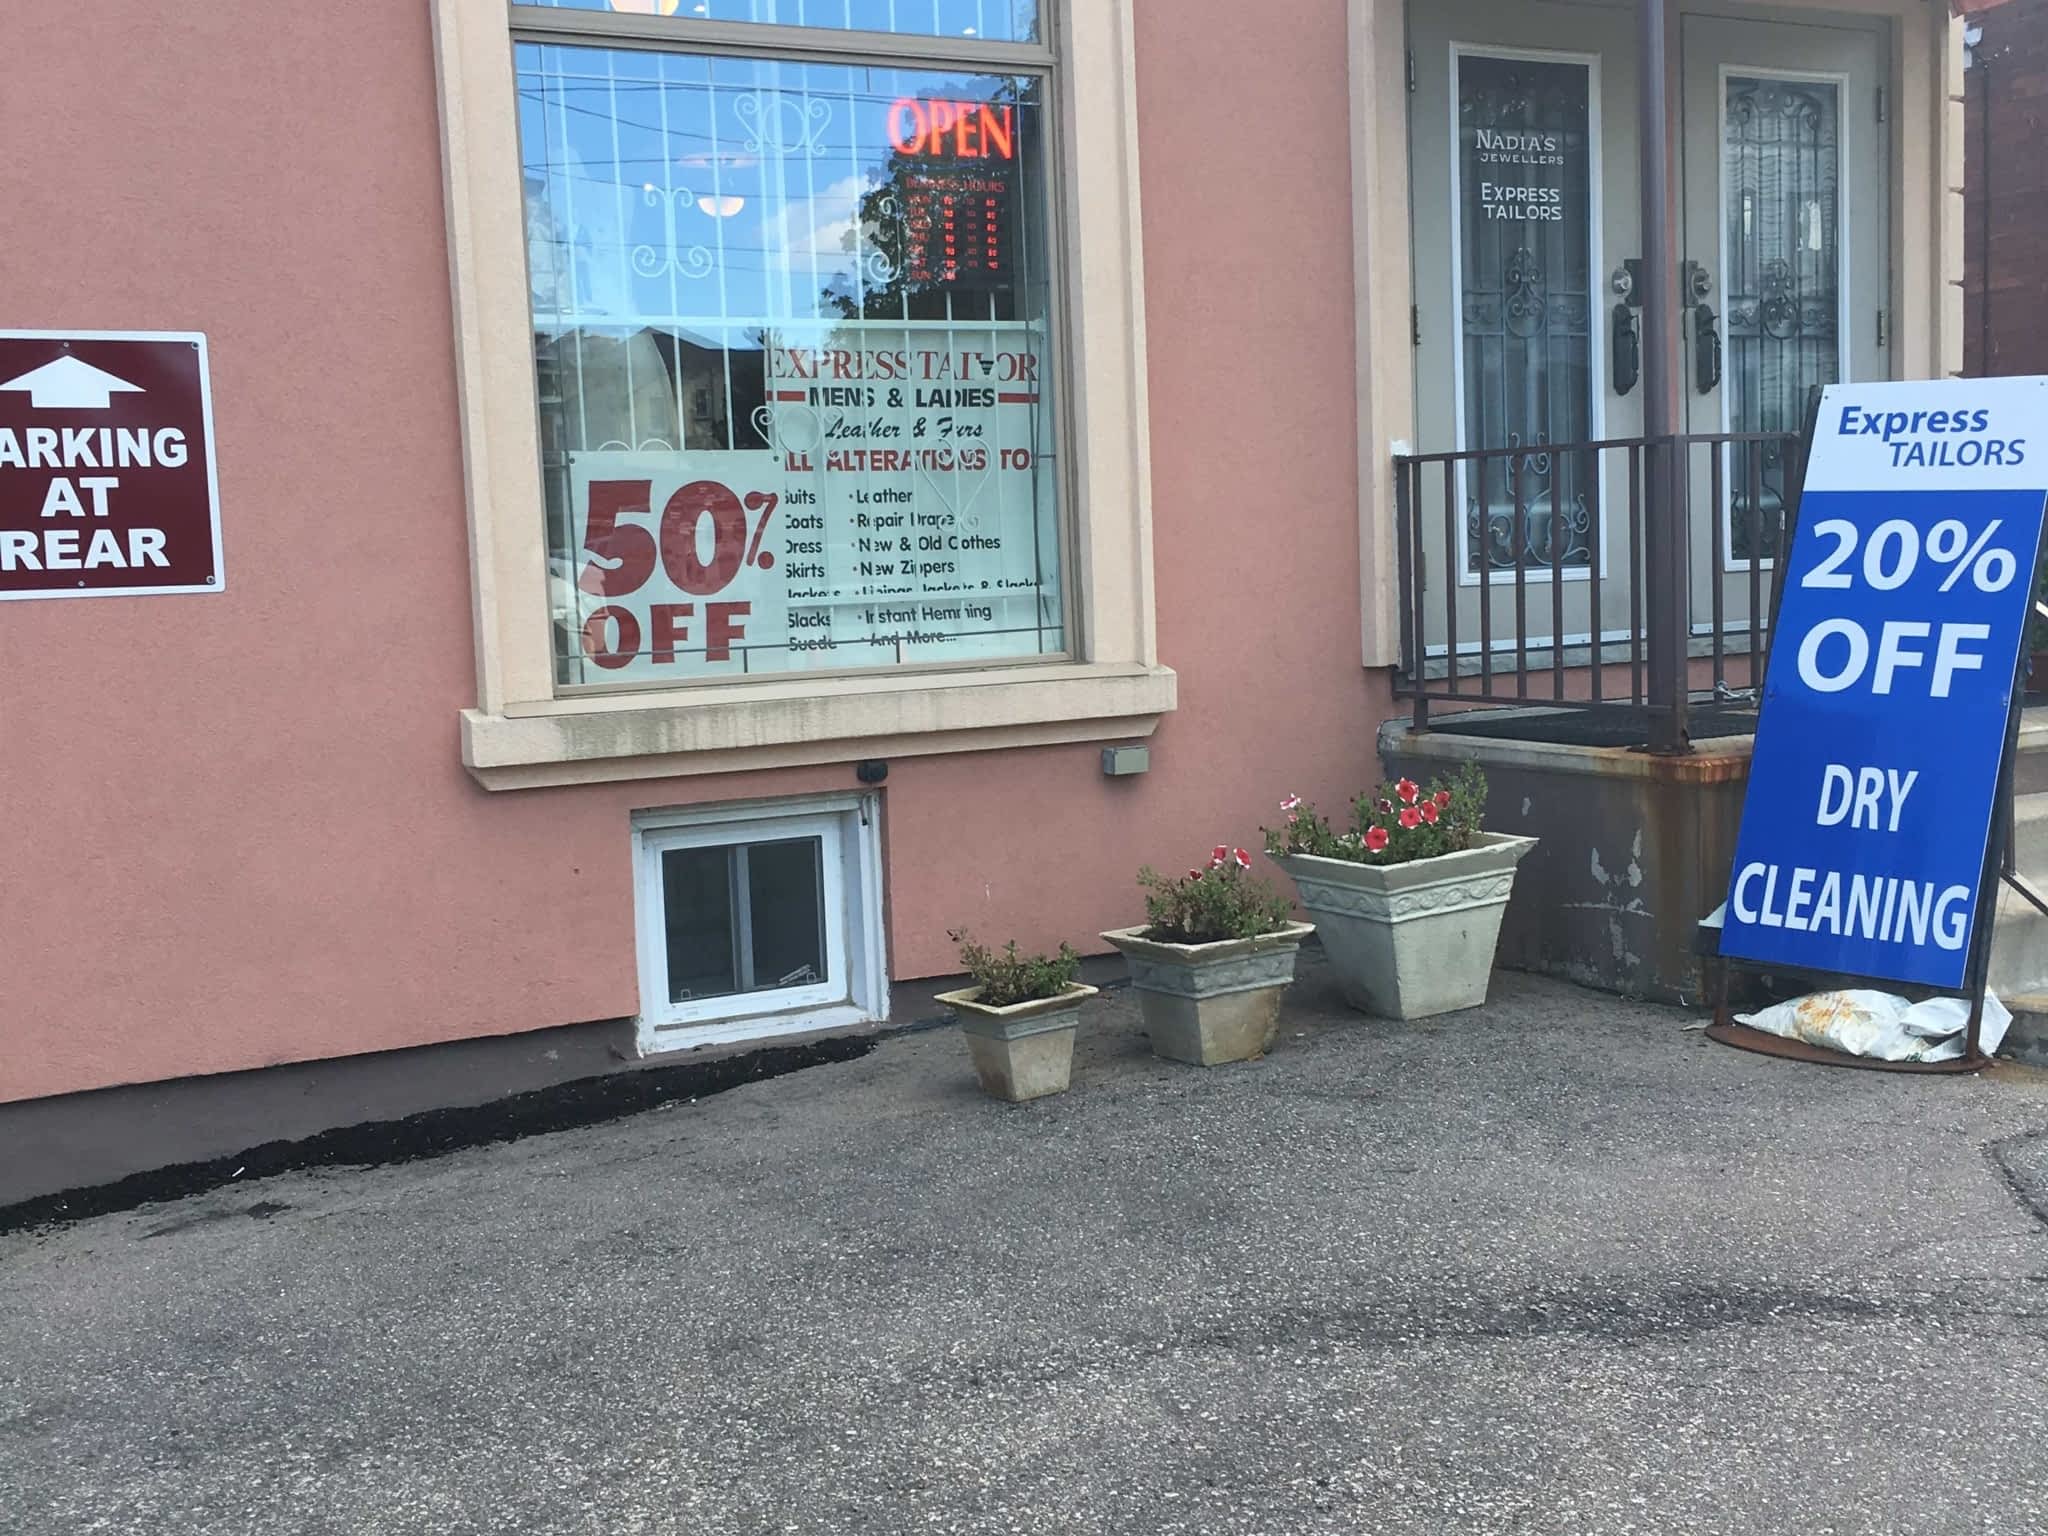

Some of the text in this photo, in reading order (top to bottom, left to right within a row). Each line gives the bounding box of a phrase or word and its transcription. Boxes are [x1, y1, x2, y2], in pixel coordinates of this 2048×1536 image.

[888, 97, 1013, 160] OPEN
[1475, 129, 1556, 151] NADIA'S
[1480, 153, 1564, 165] JEWELLERS
[1481, 182, 1560, 202] EXPRESS
[1482, 204, 1562, 220] TAILORS
[809, 387, 995, 408] MENS & LADIES
[913, 417, 926, 438] &
[1838, 406, 1988, 442] Express
[0, 428, 188, 468] ARKING
[1889, 439, 2024, 467] TAILORS
[40, 477, 119, 517] AT
[0, 528, 170, 571] REAR
[578, 480, 778, 597] 50%
[900, 537, 911, 551] &
[918, 536, 942, 551] Old
[948, 535, 1000, 551] Cothes
[1801, 518, 2016, 593] 20%
[785, 562, 824, 578] Skirts
[582, 601, 751, 669] OFF
[789, 610, 831, 628] Slacks
[1797, 618, 1990, 697] OFF
[1816, 764, 1917, 832] DRY
[1733, 861, 1970, 950] CLEANING
